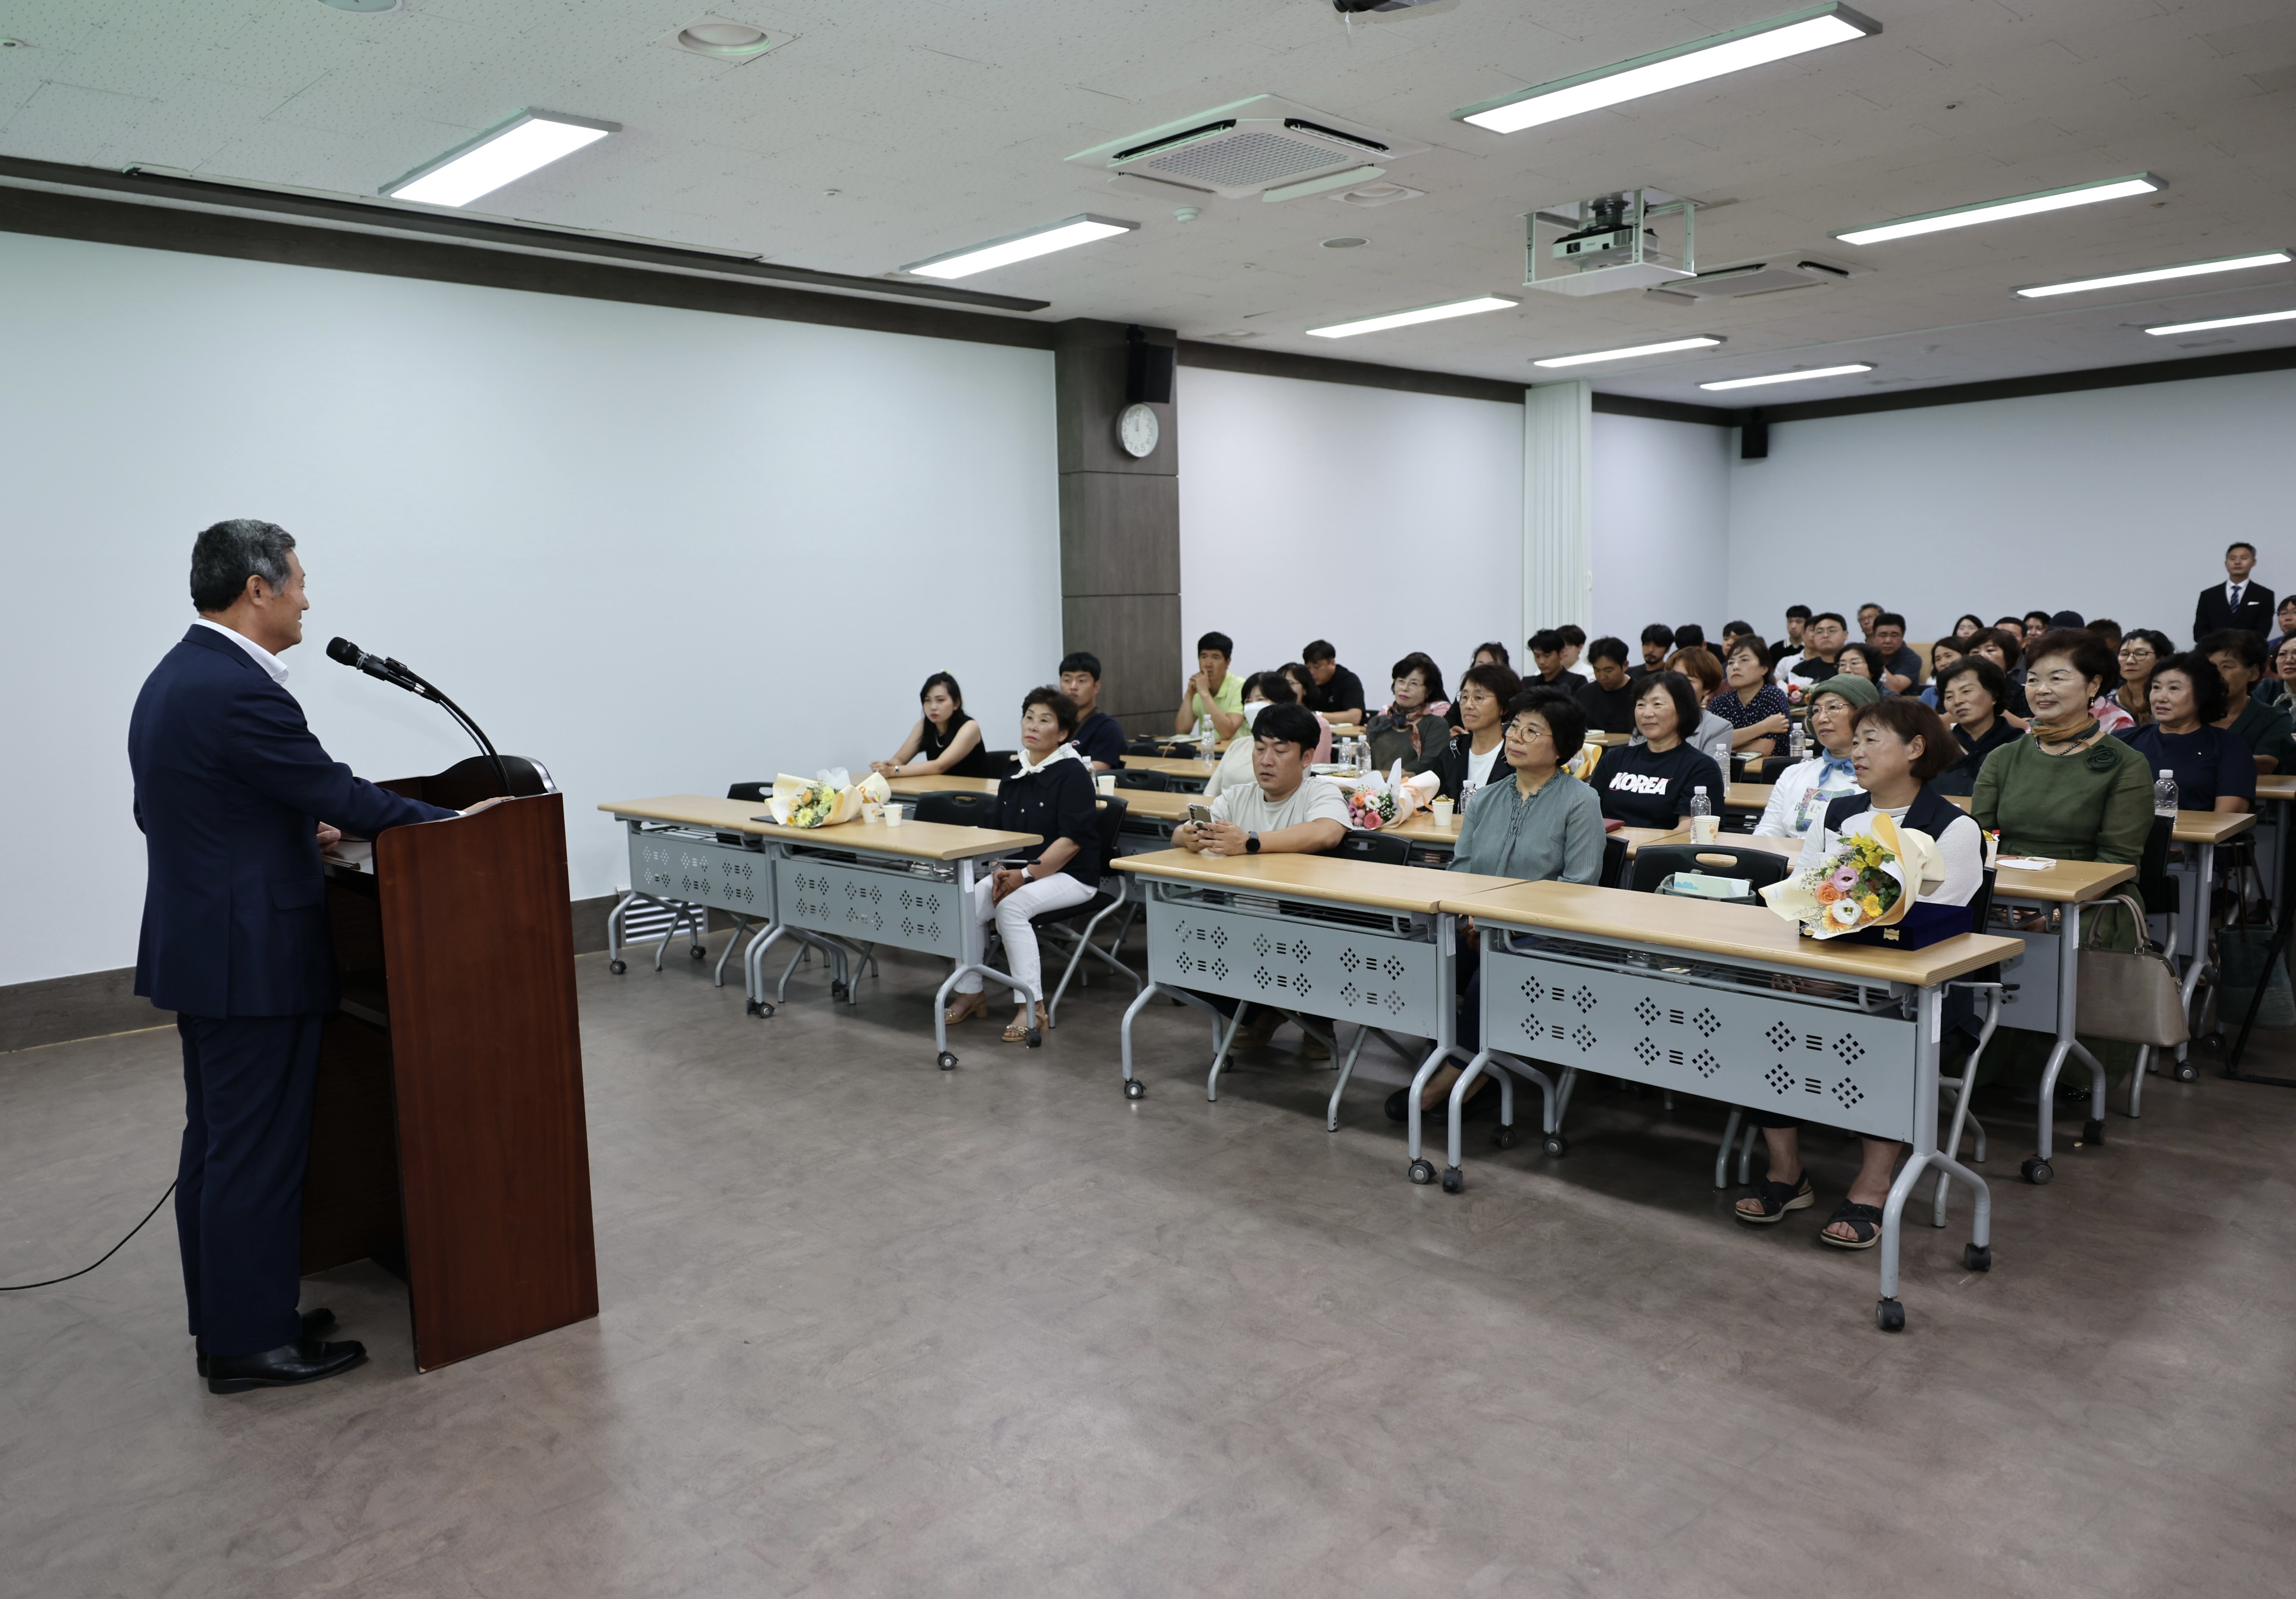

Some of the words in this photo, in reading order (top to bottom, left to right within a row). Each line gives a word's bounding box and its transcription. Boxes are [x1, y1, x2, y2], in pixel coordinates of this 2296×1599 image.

[1134, 444, 1139, 453] 6
[1140, 443, 1146, 452] 5
[1609, 772, 1669, 795] KOREA
